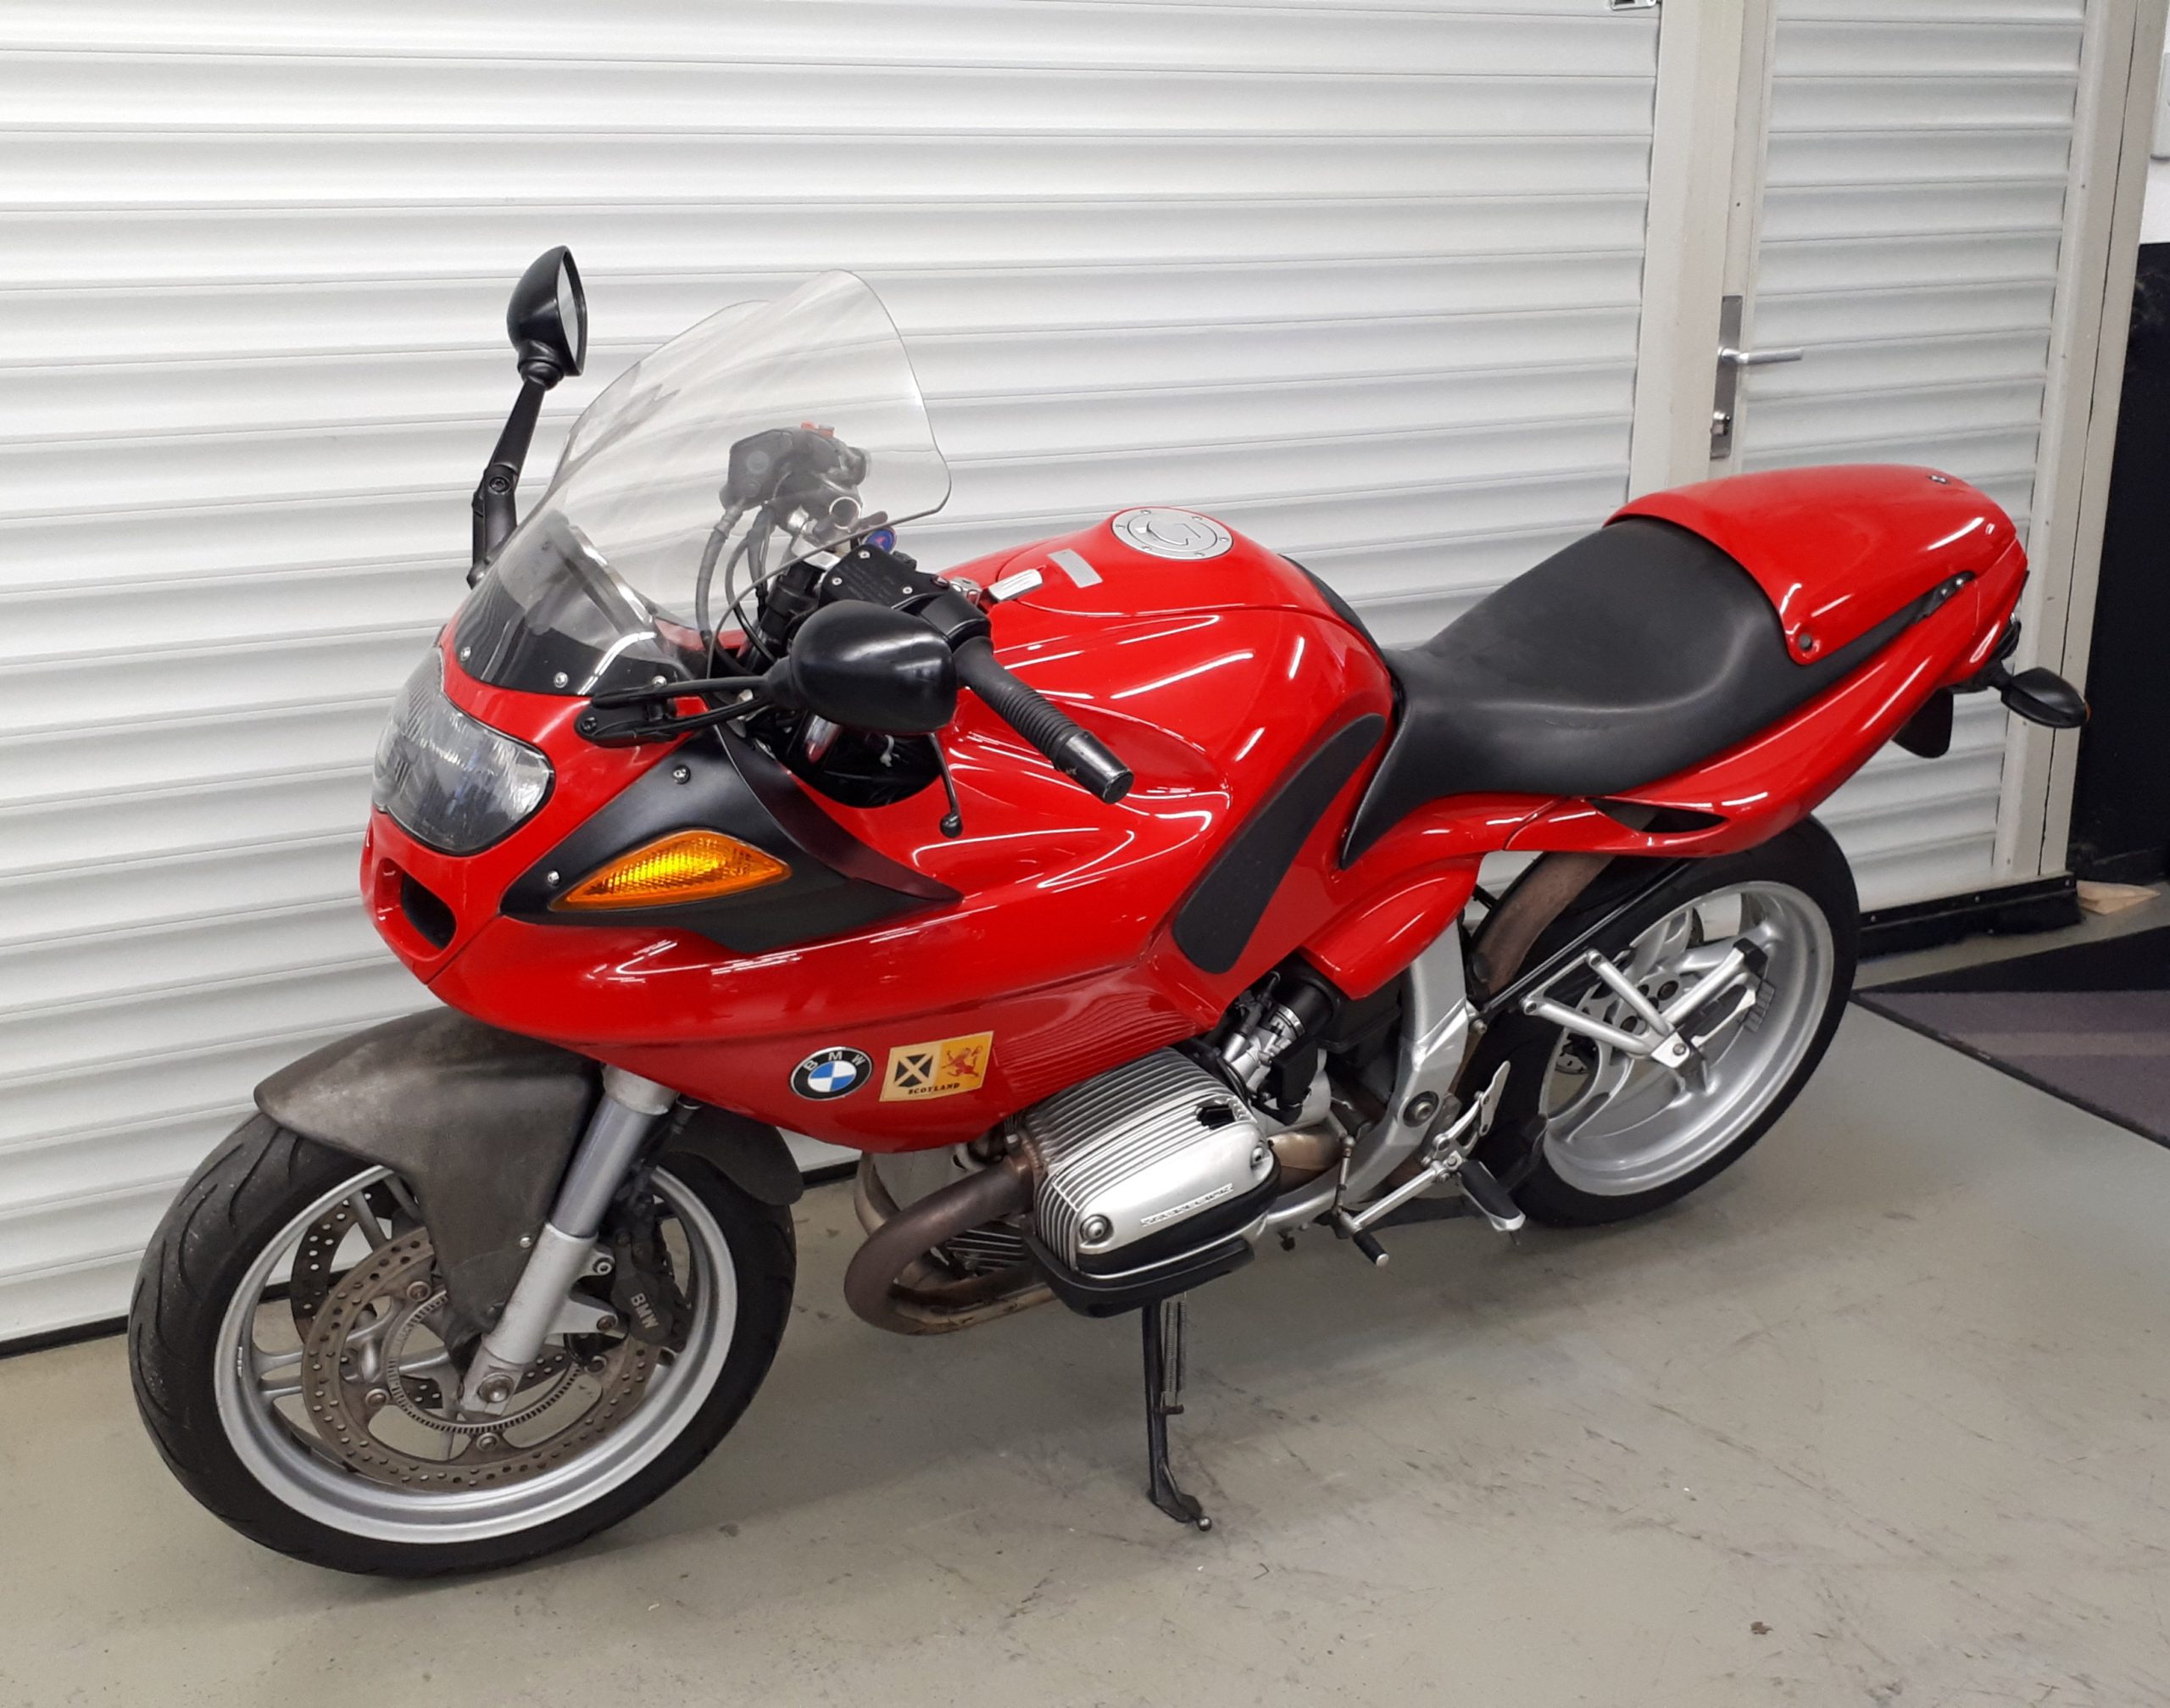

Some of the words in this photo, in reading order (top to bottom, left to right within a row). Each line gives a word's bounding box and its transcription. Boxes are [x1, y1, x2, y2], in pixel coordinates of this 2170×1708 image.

[803, 1050, 865, 1071] BMW
[908, 1082, 960, 1094] SCOTLAND
[631, 1293, 659, 1329] BMW
